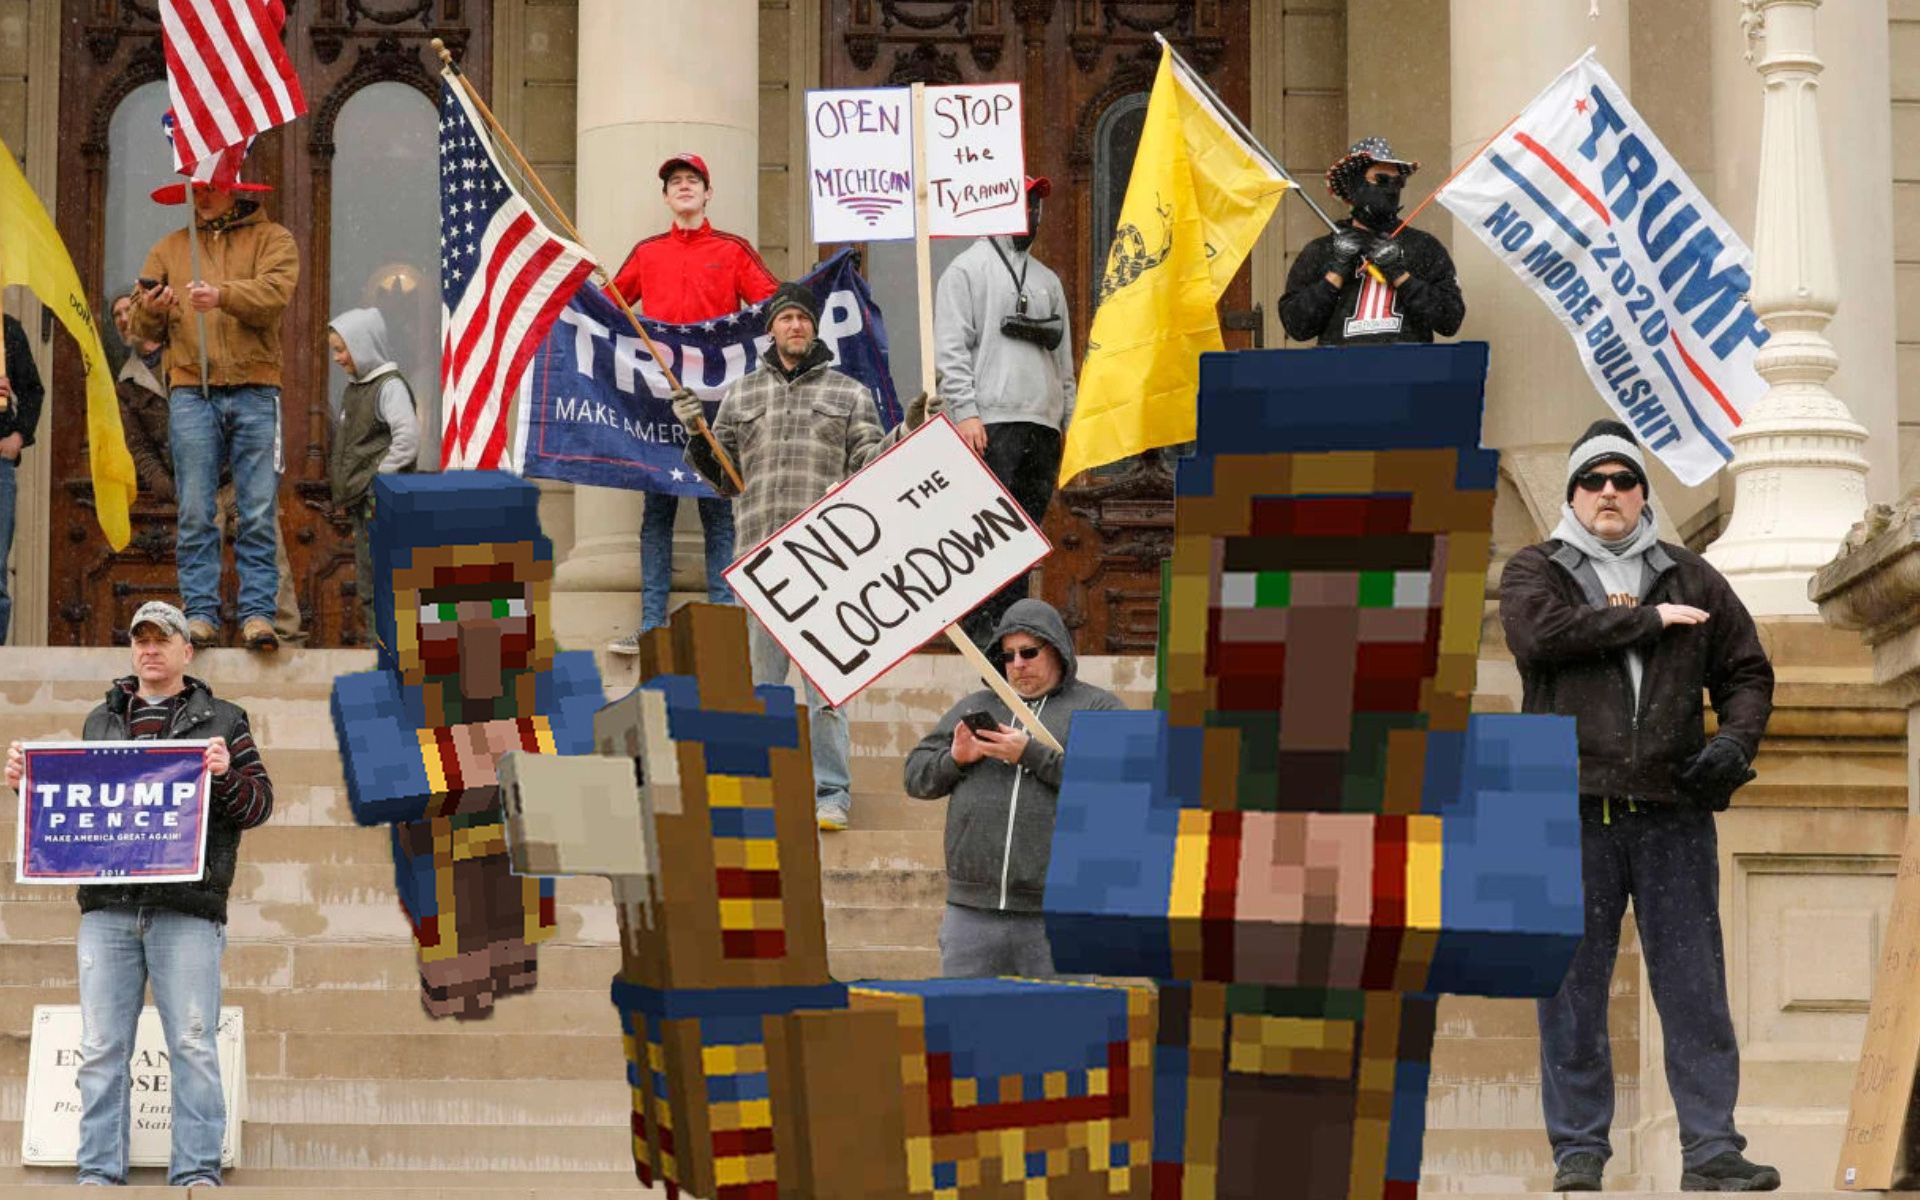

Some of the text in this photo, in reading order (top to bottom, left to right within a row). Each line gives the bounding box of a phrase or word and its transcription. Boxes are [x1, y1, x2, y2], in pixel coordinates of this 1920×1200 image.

[815, 99, 900, 138] OPEN
[934, 94, 1014, 139] STOP
[953, 146, 994, 164] the
[814, 168, 911, 197] MICHIGAN
[1590, 231, 1674, 348] 2020
[559, 290, 864, 401] TRUP
[1482, 201, 1682, 452] NO MORE BULLSHIT
[555, 397, 619, 429] MAKE
[743, 469, 950, 623] END THE
[800, 496, 1028, 676] LOCKDOWN
[37, 782, 196, 808] TRUMP
[44, 833, 182, 842] MAKE AMERICA GREAT AGAIN!
[50, 812, 179, 828] PENCE
